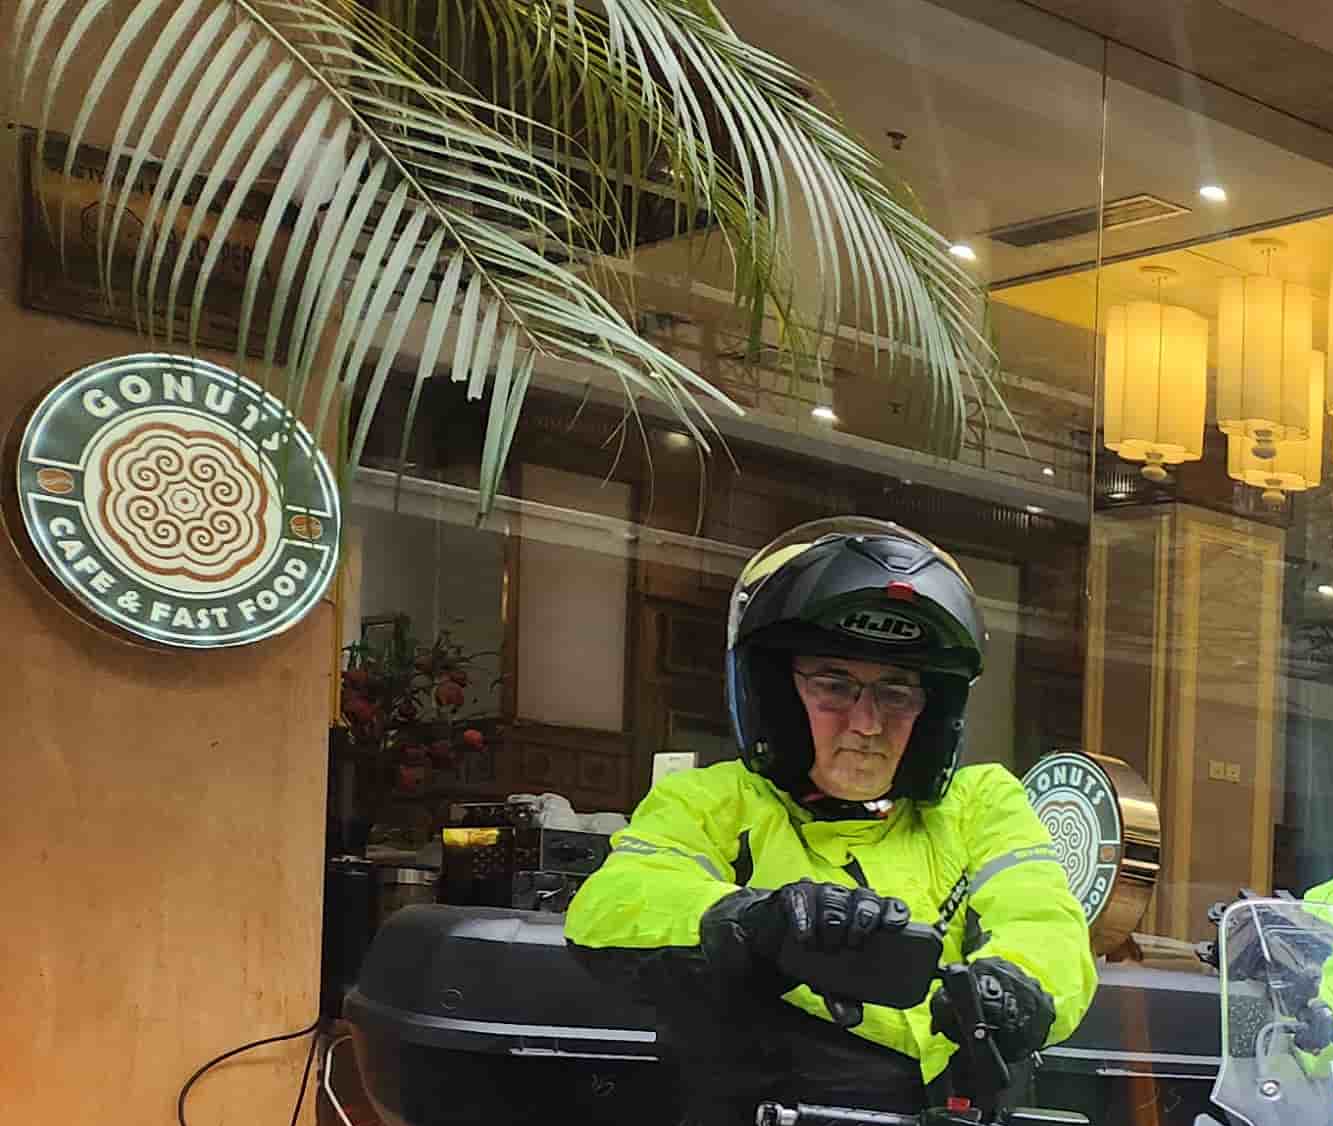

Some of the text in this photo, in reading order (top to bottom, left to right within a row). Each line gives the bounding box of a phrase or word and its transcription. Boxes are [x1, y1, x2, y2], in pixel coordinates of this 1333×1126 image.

[49, 516, 310, 630] CAFE & FAST FOOD
[844, 611, 918, 638] HJC
[1083, 876, 1107, 918] OOD
